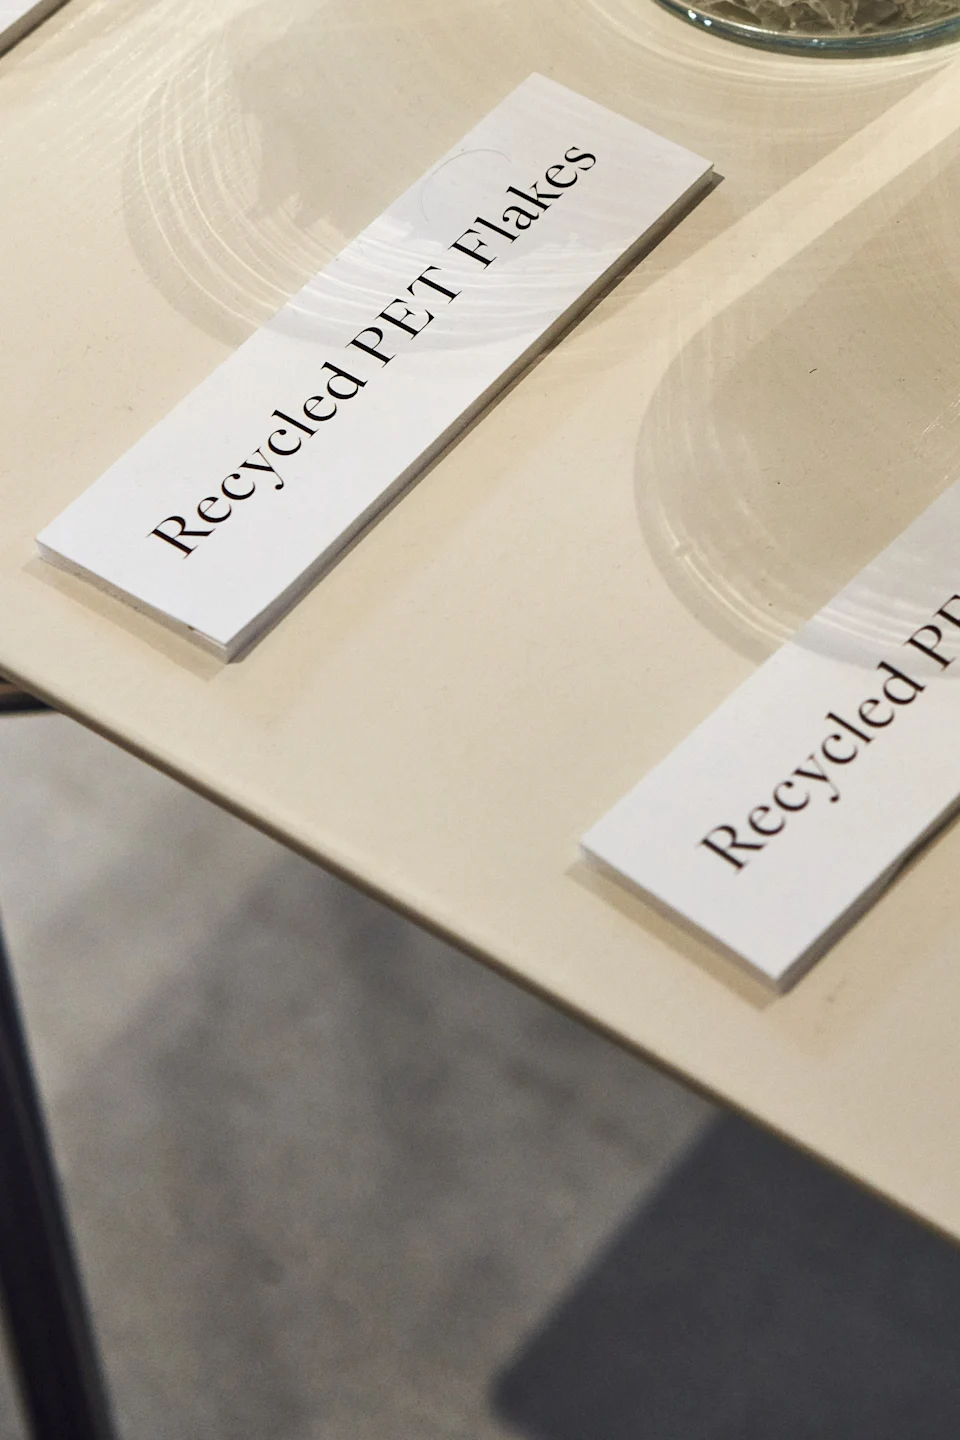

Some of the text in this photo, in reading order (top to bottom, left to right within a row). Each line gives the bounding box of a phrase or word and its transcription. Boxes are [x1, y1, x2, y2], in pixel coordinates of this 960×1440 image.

[146, 146, 597, 559] Recycled PET Flakes
[698, 660, 926, 874] Recycled
